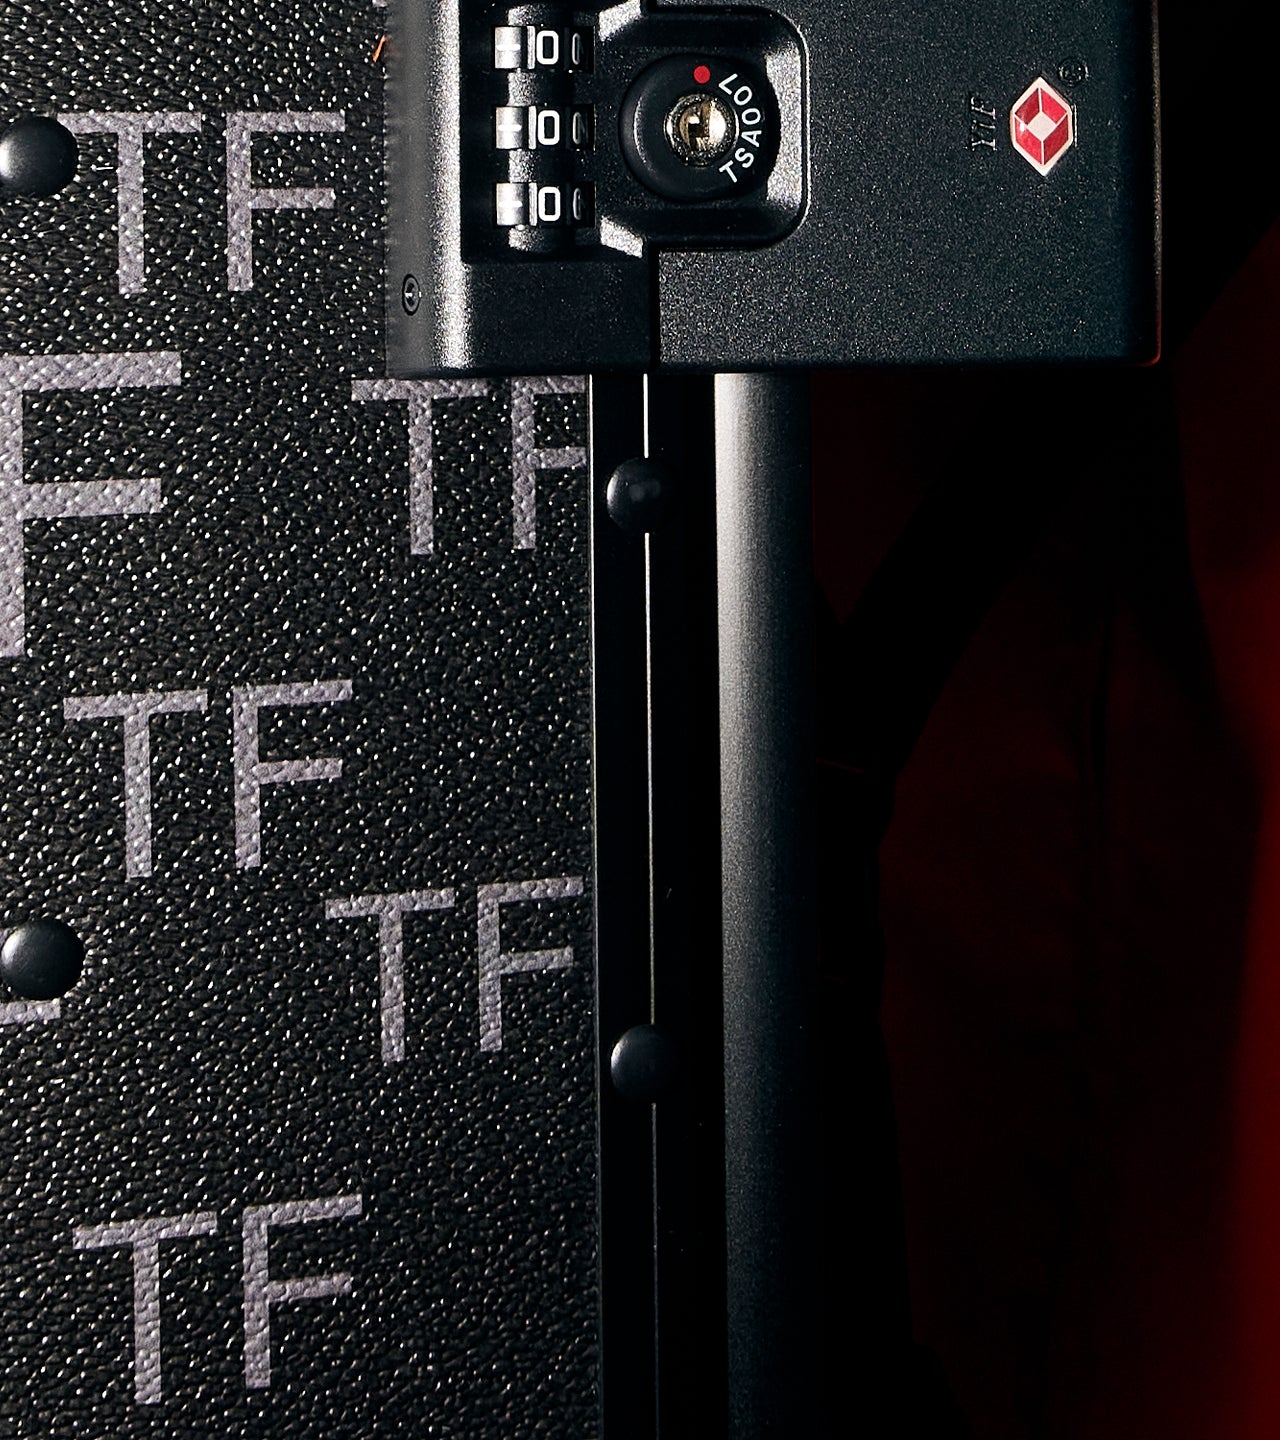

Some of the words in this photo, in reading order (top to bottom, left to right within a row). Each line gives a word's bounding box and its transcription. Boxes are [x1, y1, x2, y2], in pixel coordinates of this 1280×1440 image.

[57, 109, 347, 295] TF
[717, 72, 764, 185] TSA007
[351, 377, 587, 557] TF
[63, 679, 353, 879] TF
[324, 875, 585, 1063] TF
[72, 1193, 363, 1406] TF
